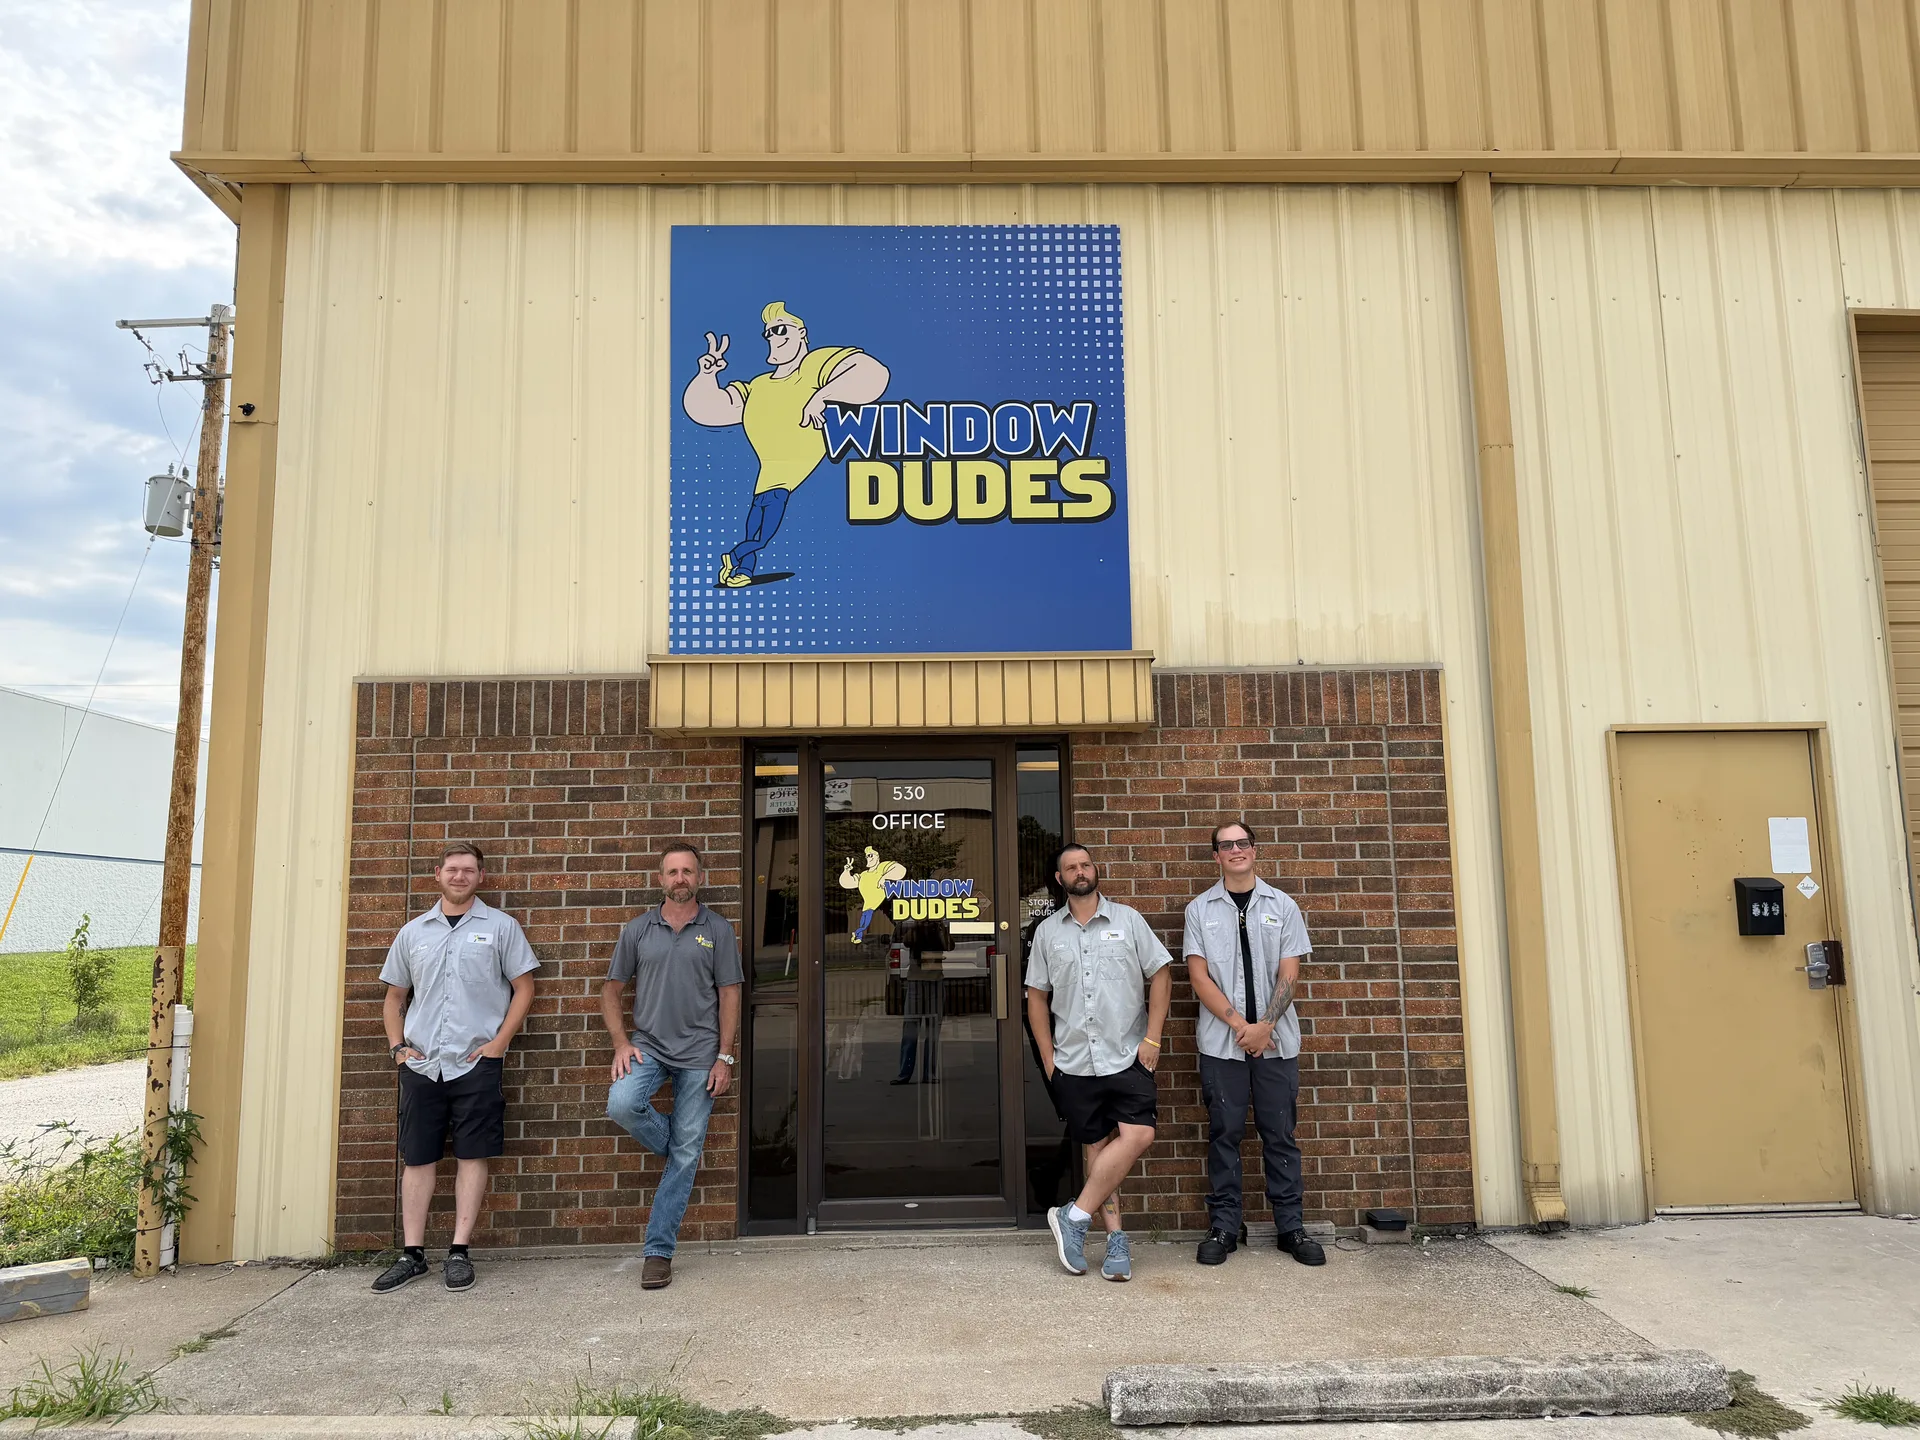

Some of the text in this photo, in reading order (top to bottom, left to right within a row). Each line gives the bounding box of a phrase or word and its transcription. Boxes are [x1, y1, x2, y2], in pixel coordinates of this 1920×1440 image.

[824, 401, 1095, 460] WINDOW
[846, 458, 1114, 522] DUDES
[893, 786, 925, 801] 530
[872, 813, 946, 830] OFFICE
[884, 879, 974, 899] WINDOW
[892, 897, 981, 921] DUDES
[1028, 899, 1055, 907] STORE
[1028, 909, 1057, 917] HOURS
